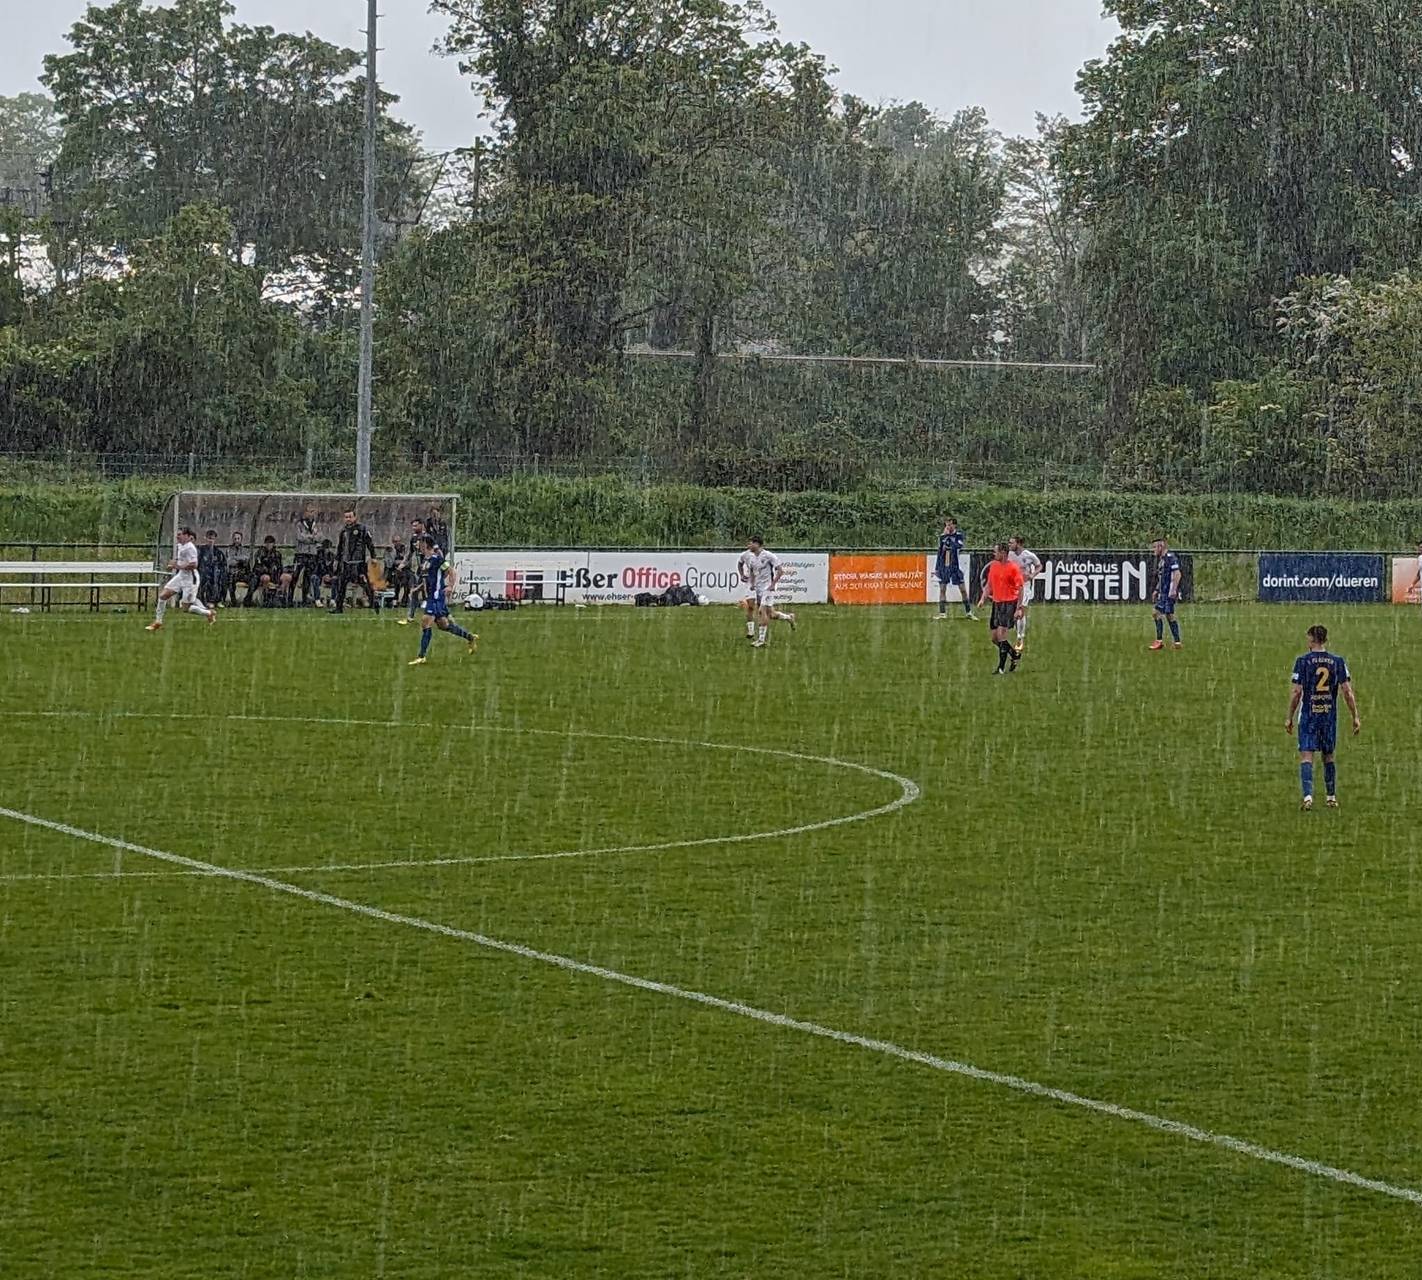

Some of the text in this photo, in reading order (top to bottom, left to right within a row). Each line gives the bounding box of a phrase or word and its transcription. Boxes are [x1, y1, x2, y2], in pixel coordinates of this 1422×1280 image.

[622, 567, 681, 589] Office
[686, 566, 739, 592] Group
[1030, 560, 1147, 600] HERTEN
[1055, 560, 1119, 574] Autohaus
[1262, 574, 1378, 589] dorint.com/dueren
[1315, 666, 1330, 692] 2
